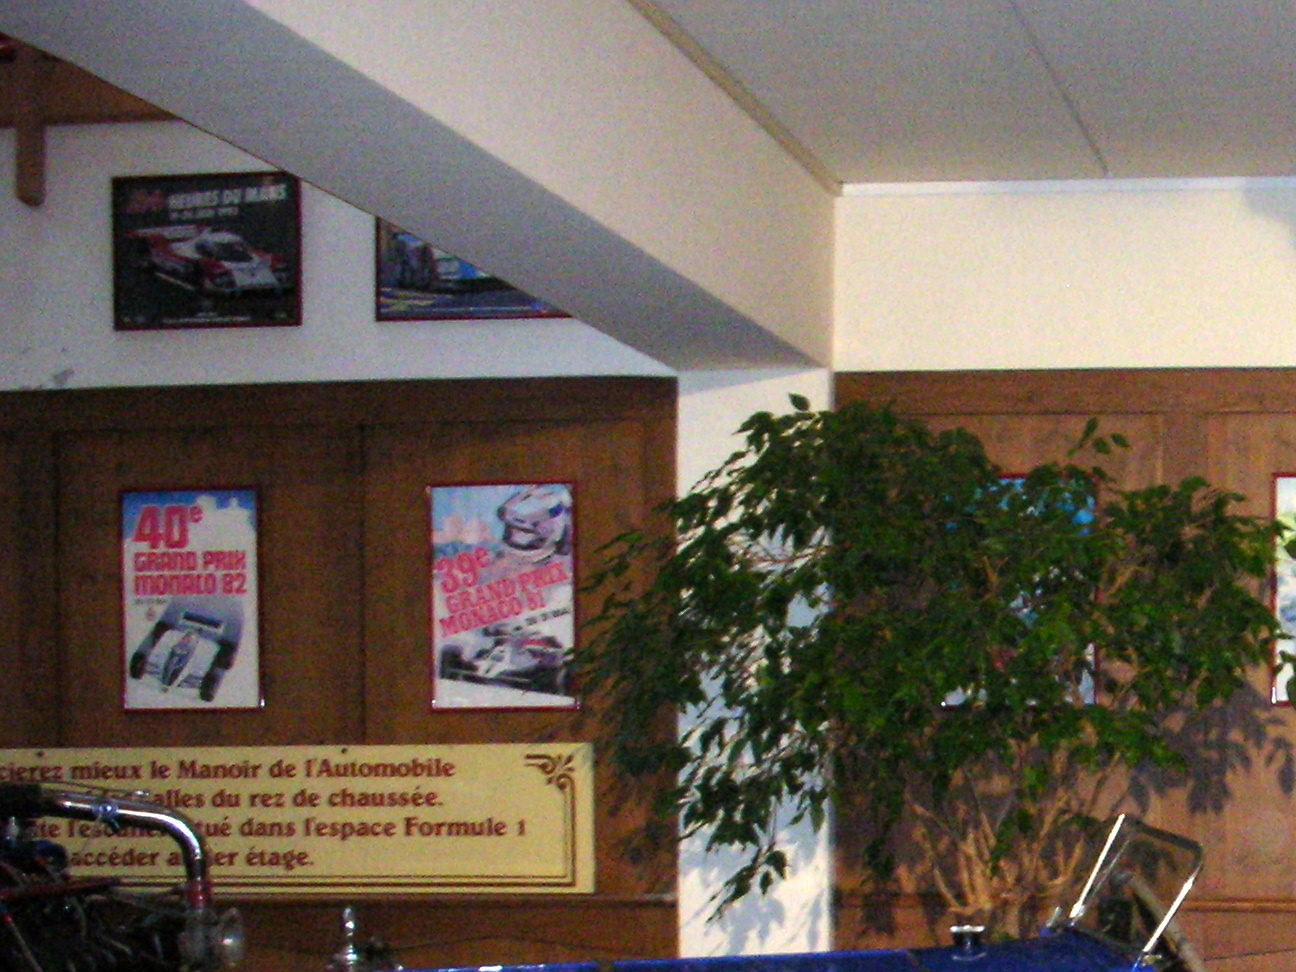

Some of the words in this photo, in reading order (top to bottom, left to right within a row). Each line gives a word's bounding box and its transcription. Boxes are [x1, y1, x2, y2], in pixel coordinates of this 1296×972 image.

[70, 762, 143, 780] mieux
[150, 760, 170, 779] le
[177, 759, 262, 780] Manoir
[268, 759, 297, 779] de
[304, 758, 456, 778] l'Automobile
[148, 789, 206, 808] alles
[211, 788, 242, 808] du
[249, 791, 287, 808] rez
[292, 788, 321, 807] de
[327, 786, 444, 807] chaussée.
[239, 818, 296, 838] dans
[304, 816, 397, 841] l'espace
[403, 816, 507, 837] Formule
[516, 819, 527, 837] 1
[70, 847, 160, 867] accéder
[246, 848, 315, 871] étage.
